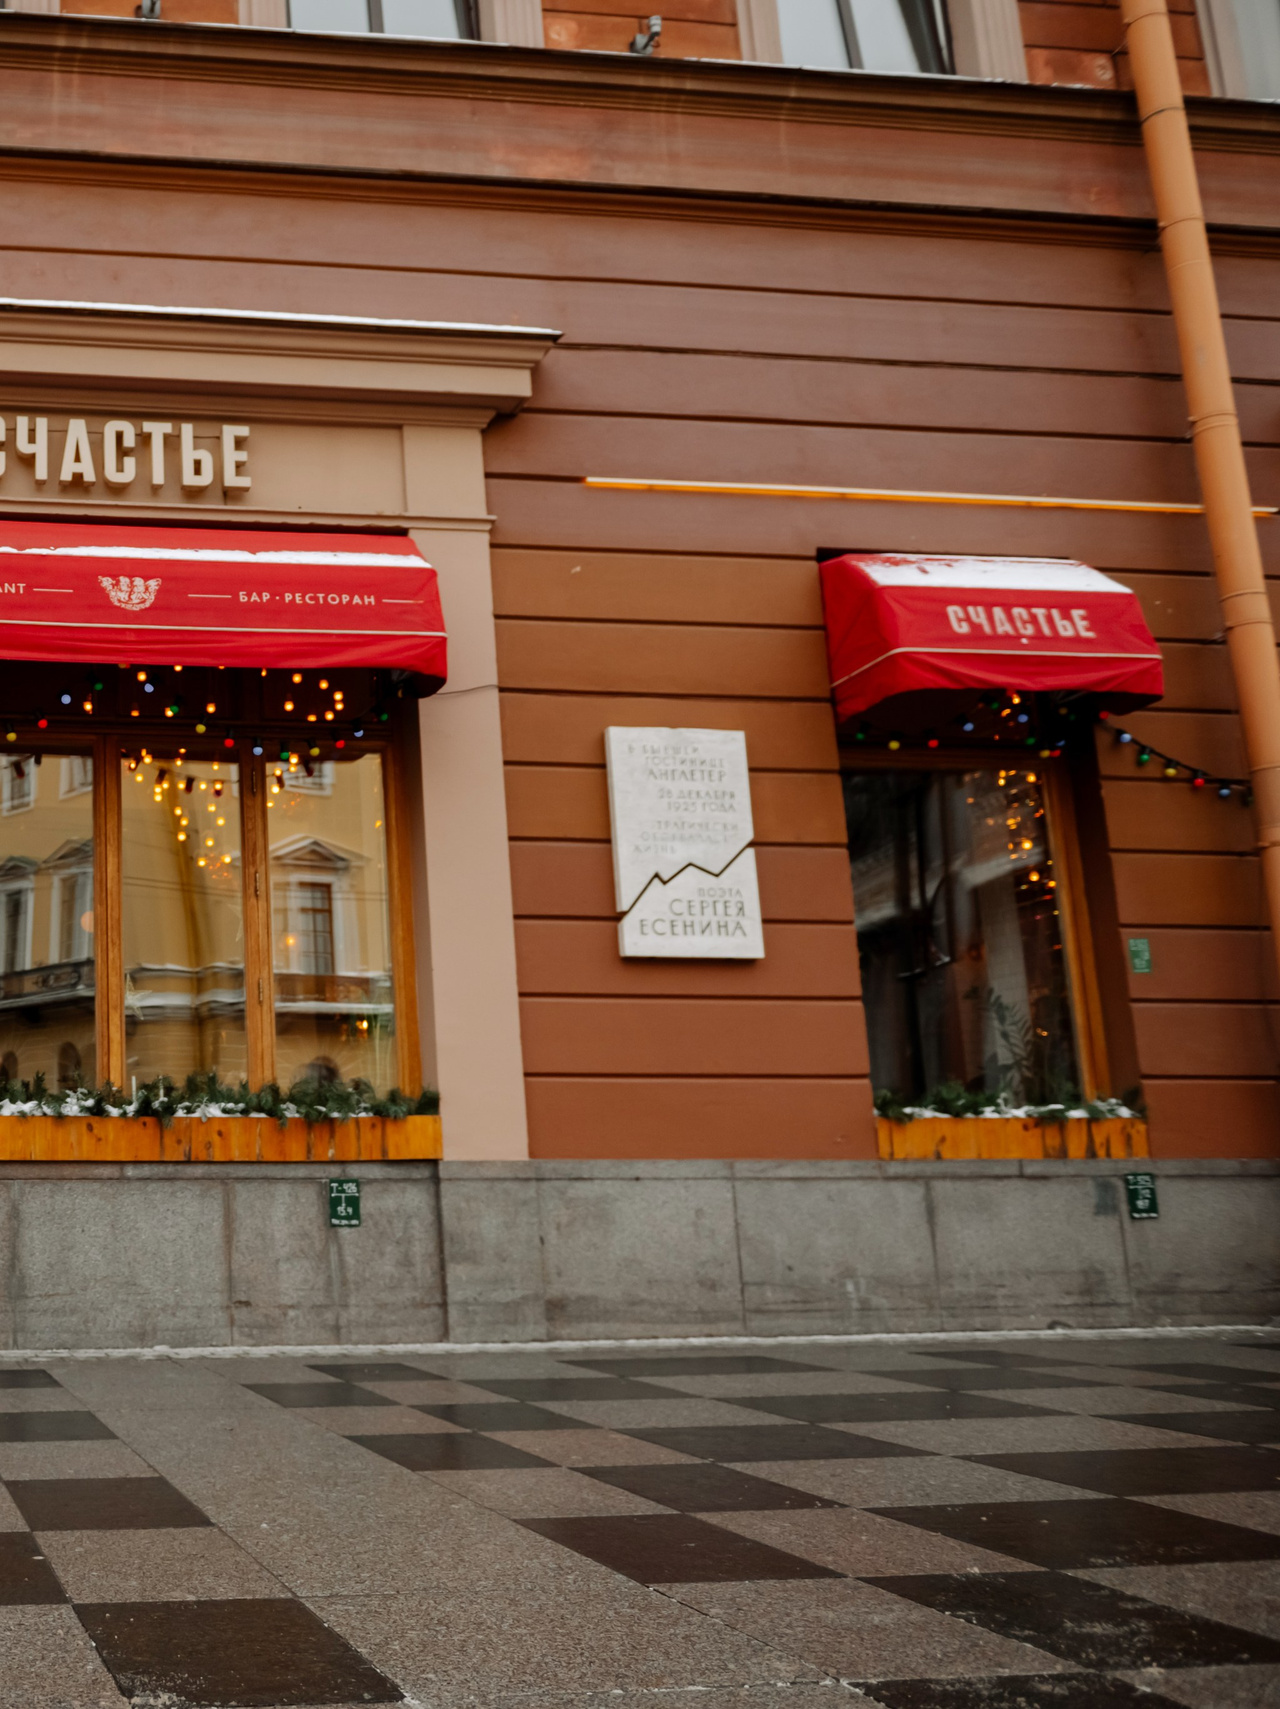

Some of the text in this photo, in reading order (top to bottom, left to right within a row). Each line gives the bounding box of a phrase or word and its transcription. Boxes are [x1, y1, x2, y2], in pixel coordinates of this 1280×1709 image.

[239, 591, 375, 606] БАР РЕСТОРАН
[946, 605, 1097, 639] СЧАСТЬЕ
[648, 768, 726, 782] АНГЛЕТЕР
[666, 800, 736, 813] 1925 ГОДА
[697, 887, 743, 898] ПОЭТА
[669, 898, 745, 917] СЕРГЕЯ
[639, 918, 747, 937] ЕСЕНИНА
